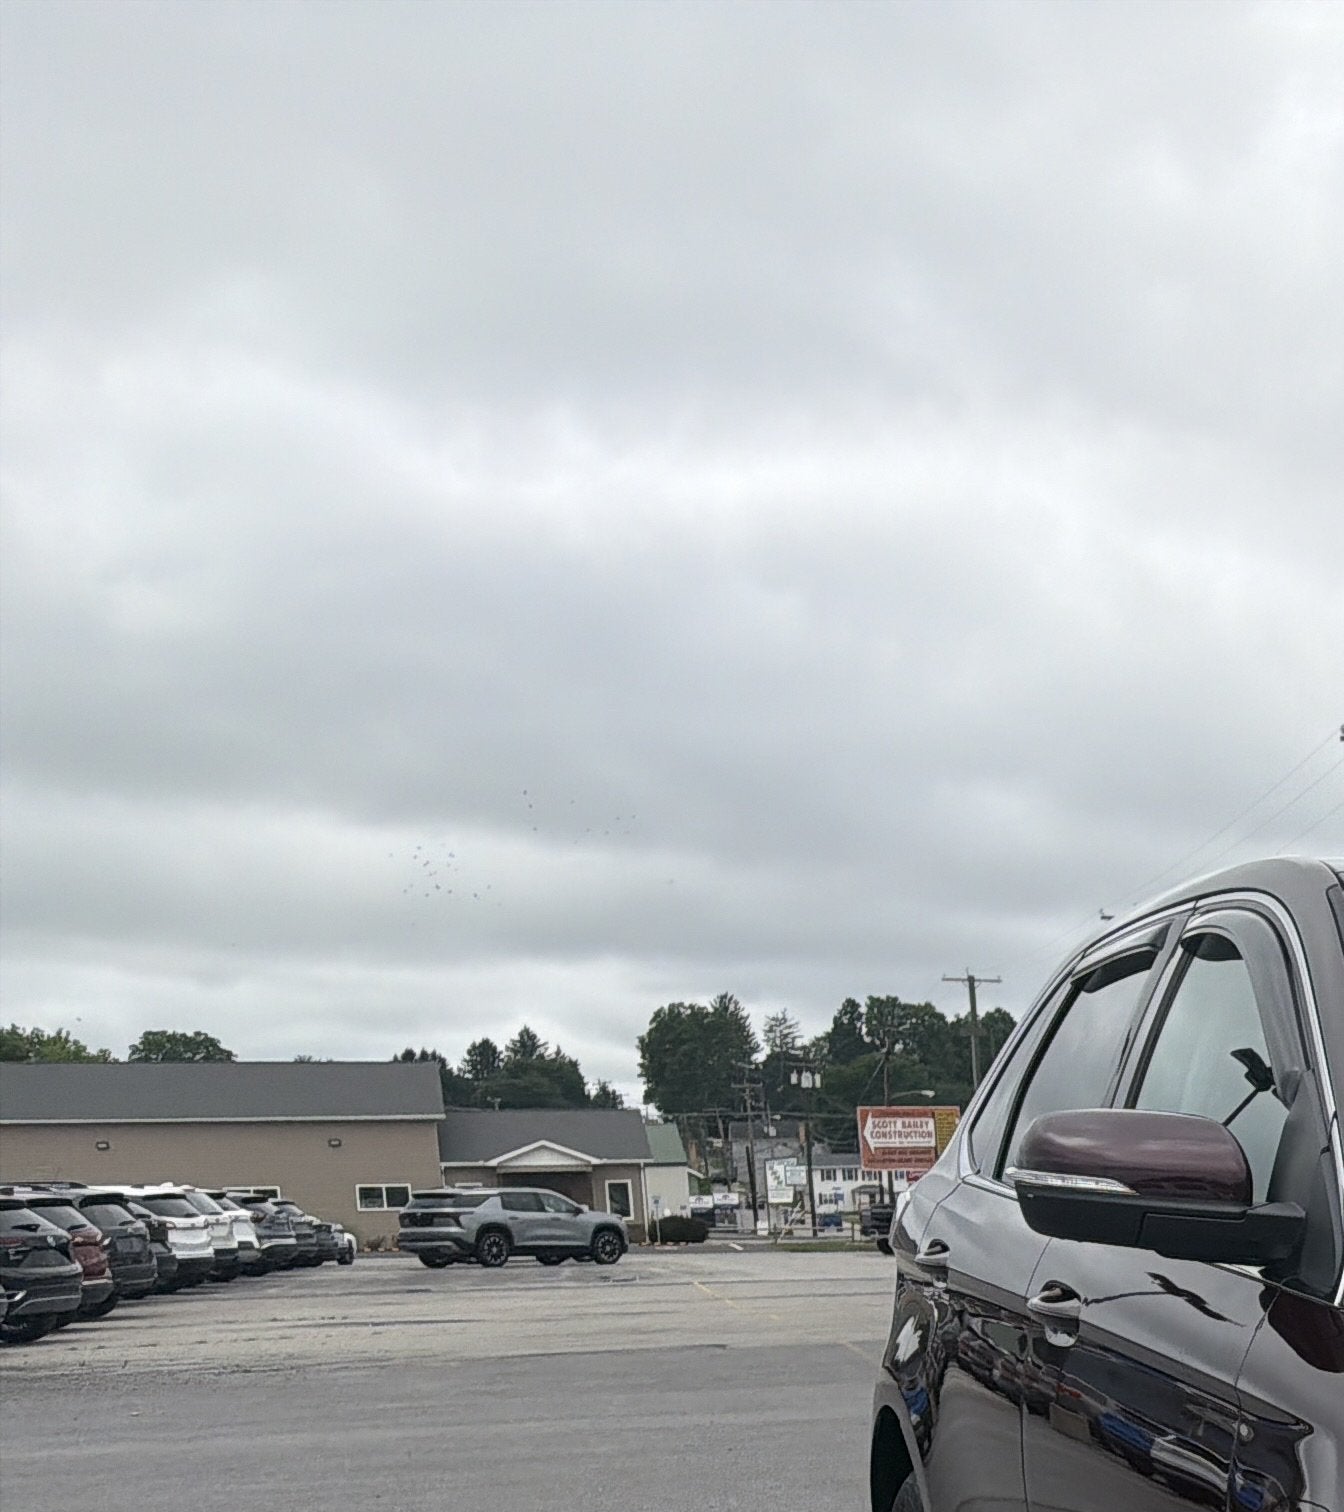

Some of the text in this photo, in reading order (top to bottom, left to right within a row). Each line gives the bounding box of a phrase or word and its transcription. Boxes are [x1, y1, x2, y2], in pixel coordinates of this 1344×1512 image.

[871, 1120, 930, 1130] SCOTT BAILEY
[869, 1130, 933, 1140] CONSTRUCTION
